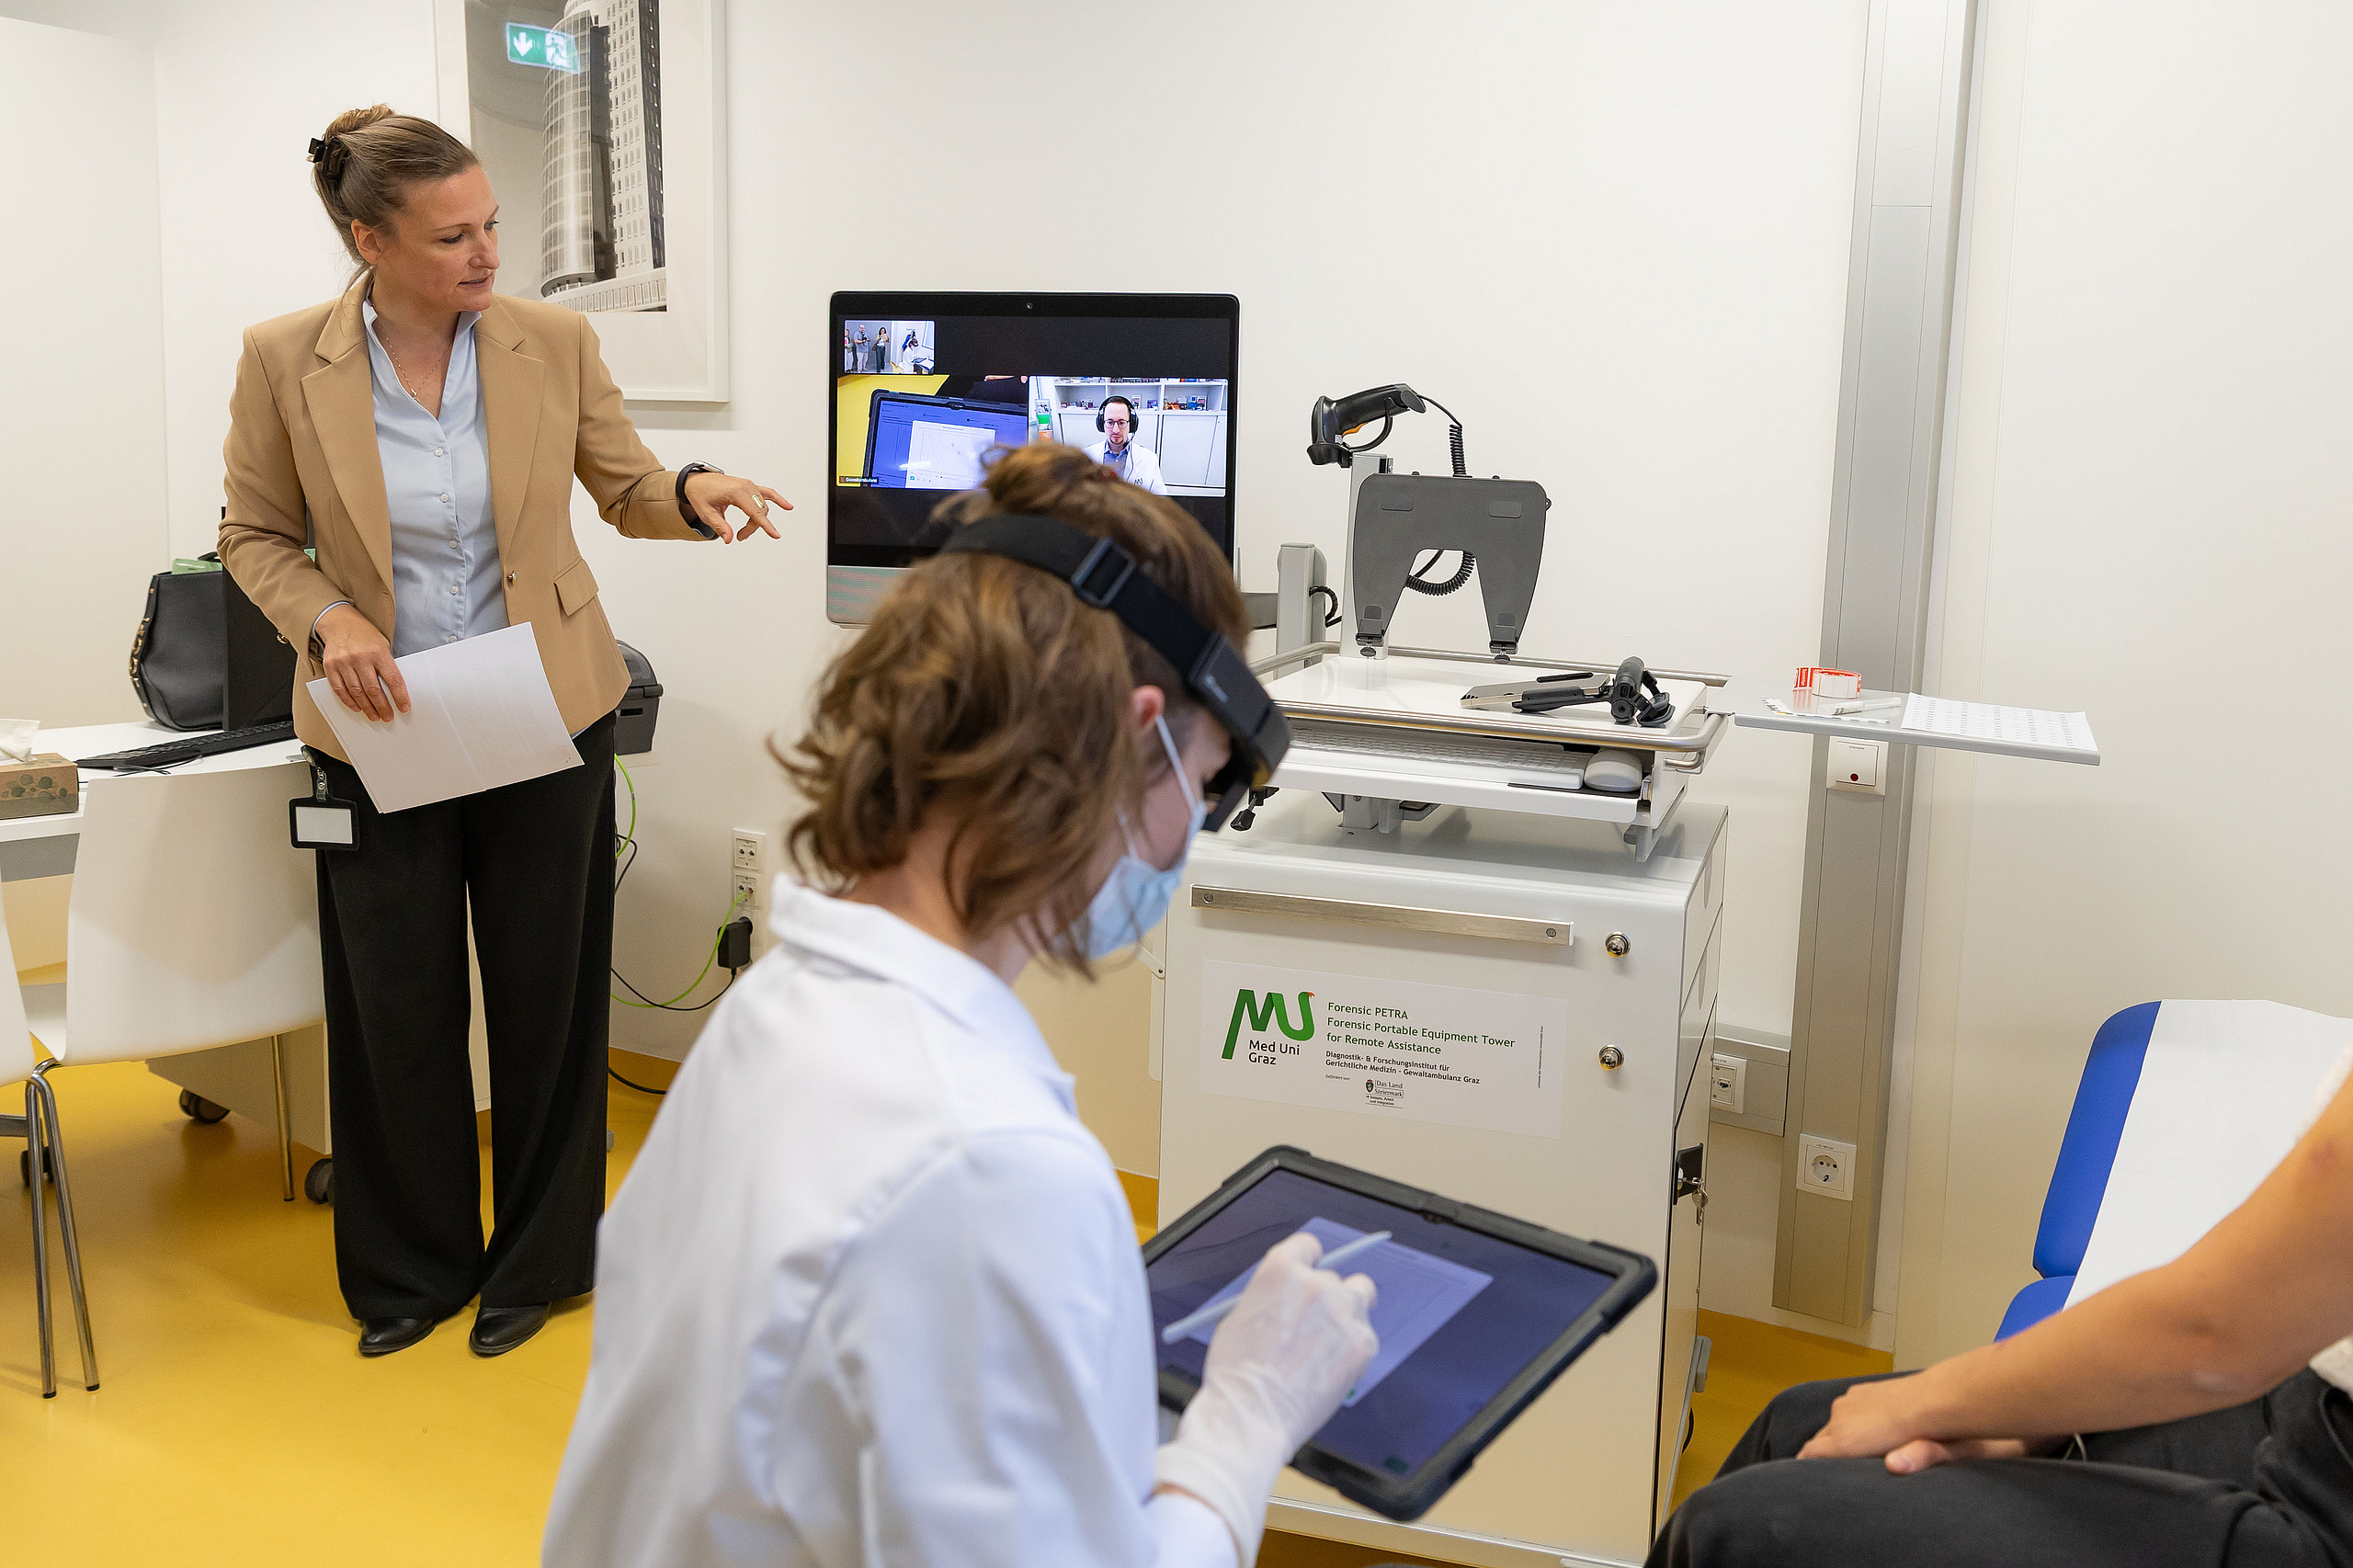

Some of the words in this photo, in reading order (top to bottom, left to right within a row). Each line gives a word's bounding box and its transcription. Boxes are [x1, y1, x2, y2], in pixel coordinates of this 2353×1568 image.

[1328, 1002, 1371, 1016] Forensic
[1375, 1007, 1408, 1019] PETRA
[1327, 1017, 1371, 1030] Forensic
[1374, 1022, 1418, 1036] Portable
[1421, 1028, 1478, 1043] Equipment
[1482, 1035, 1516, 1048] Tower
[1249, 1040, 1276, 1052] Med
[1279, 1043, 1300, 1055] Uni
[1326, 1032, 1342, 1042] for
[1345, 1034, 1384, 1048] Remote
[1387, 1040, 1441, 1054] Assistance
[1248, 1051, 1277, 1065] Graz
[1325, 1051, 1364, 1061] Diagnostik-
[1373, 1056, 1438, 1071] Forschungsinstitut
[1325, 1059, 1368, 1071] Gerichtliche
[1369, 1064, 1397, 1074] Medizin
[1403, 1068, 1461, 1082] Gewaltambulanz
[1463, 1075, 1480, 1085] Graz
[1374, 1088, 1403, 1096] Steiermark
[1388, 1081, 1404, 1089] Land
